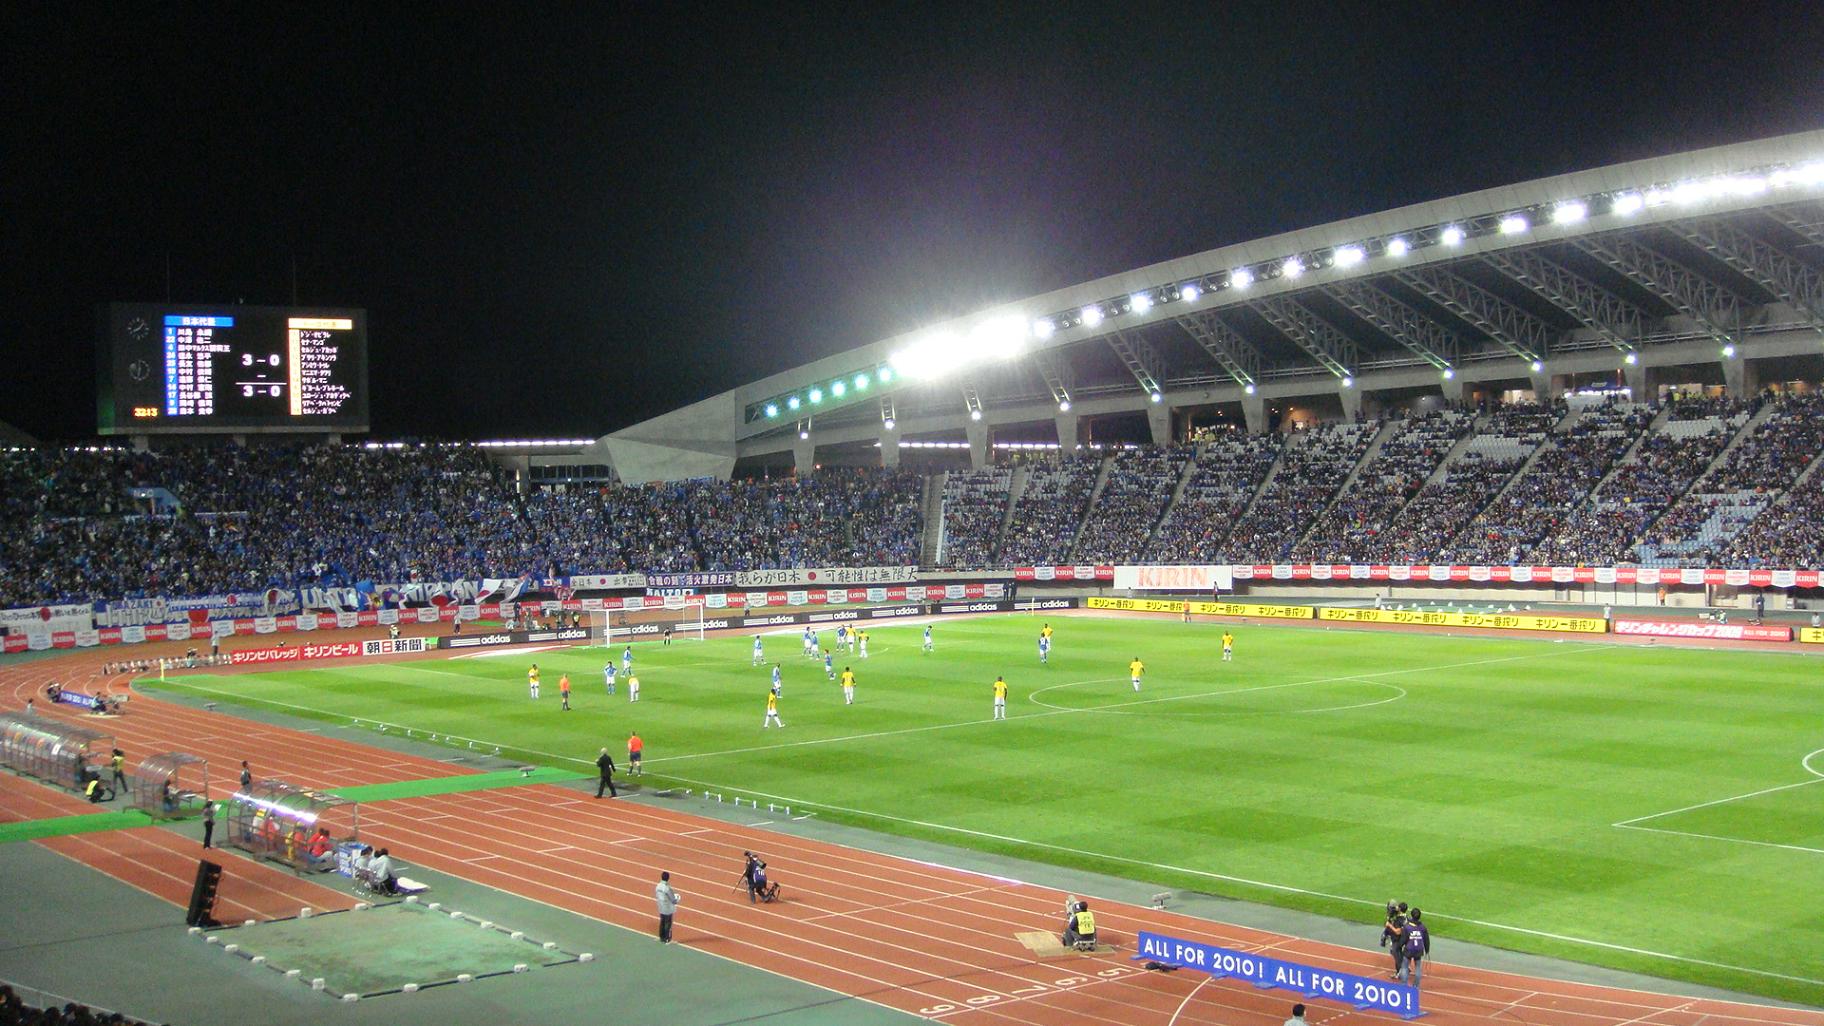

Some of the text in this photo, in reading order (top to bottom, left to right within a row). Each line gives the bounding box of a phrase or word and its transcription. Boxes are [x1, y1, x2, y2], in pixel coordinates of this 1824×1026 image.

[242, 354, 252, 366] 3
[269, 354, 280, 366] 0
[243, 385, 253, 397] 3
[270, 385, 280, 397] 0
[738, 566, 917, 586] 我らが日本 可能性は無限大
[1016, 569, 1034, 577] KIRIN
[1056, 568, 1073, 576] KIRIN
[1138, 567, 1208, 587] KIRIN
[1253, 568, 1272, 576] KIRIN
[1332, 568, 1350, 576] KIRIN
[1370, 568, 1389, 576] KIRIN
[1491, 569, 1510, 577] KIRIN
[1532, 569, 1551, 578] KIRIN
[1574, 570, 1593, 578] KIRIN
[1616, 571, 1636, 580] KIRIN
[1660, 572, 1681, 580] KIRIN
[1704, 573, 1725, 581] KIRIN
[1750, 574, 1771, 583] KIRIN
[1796, 575, 1817, 584] KIRIN
[887, 590, 905, 598] KIRIN
[927, 588, 945, 596] KIRIN
[966, 587, 984, 595] KIRIN
[969, 603, 998, 612] adidas
[1041, 599, 1069, 609] adidas
[1145, 600, 1184, 611] キリン一番搾
[833, 611, 858, 621] adidas
[895, 606, 919, 616] adidas
[769, 615, 794, 625] adidas
[631, 624, 659, 634] adidas
[557, 629, 587, 640] adidas
[480, 634, 511, 646] adidas
[304, 642, 359, 658] キリンビール
[366, 637, 422, 655] 朝日新聞
[1144, 937, 1170, 959] ALL
[1176, 945, 1205, 966] FOR
[1097, 966, 1133, 977] 5
[1275, 966, 1305, 988] ALL
[1312, 974, 1345, 996] FOR
[1012, 985, 1048, 995] 7
[966, 994, 1001, 1005] 8
[920, 1003, 956, 1015] 9
